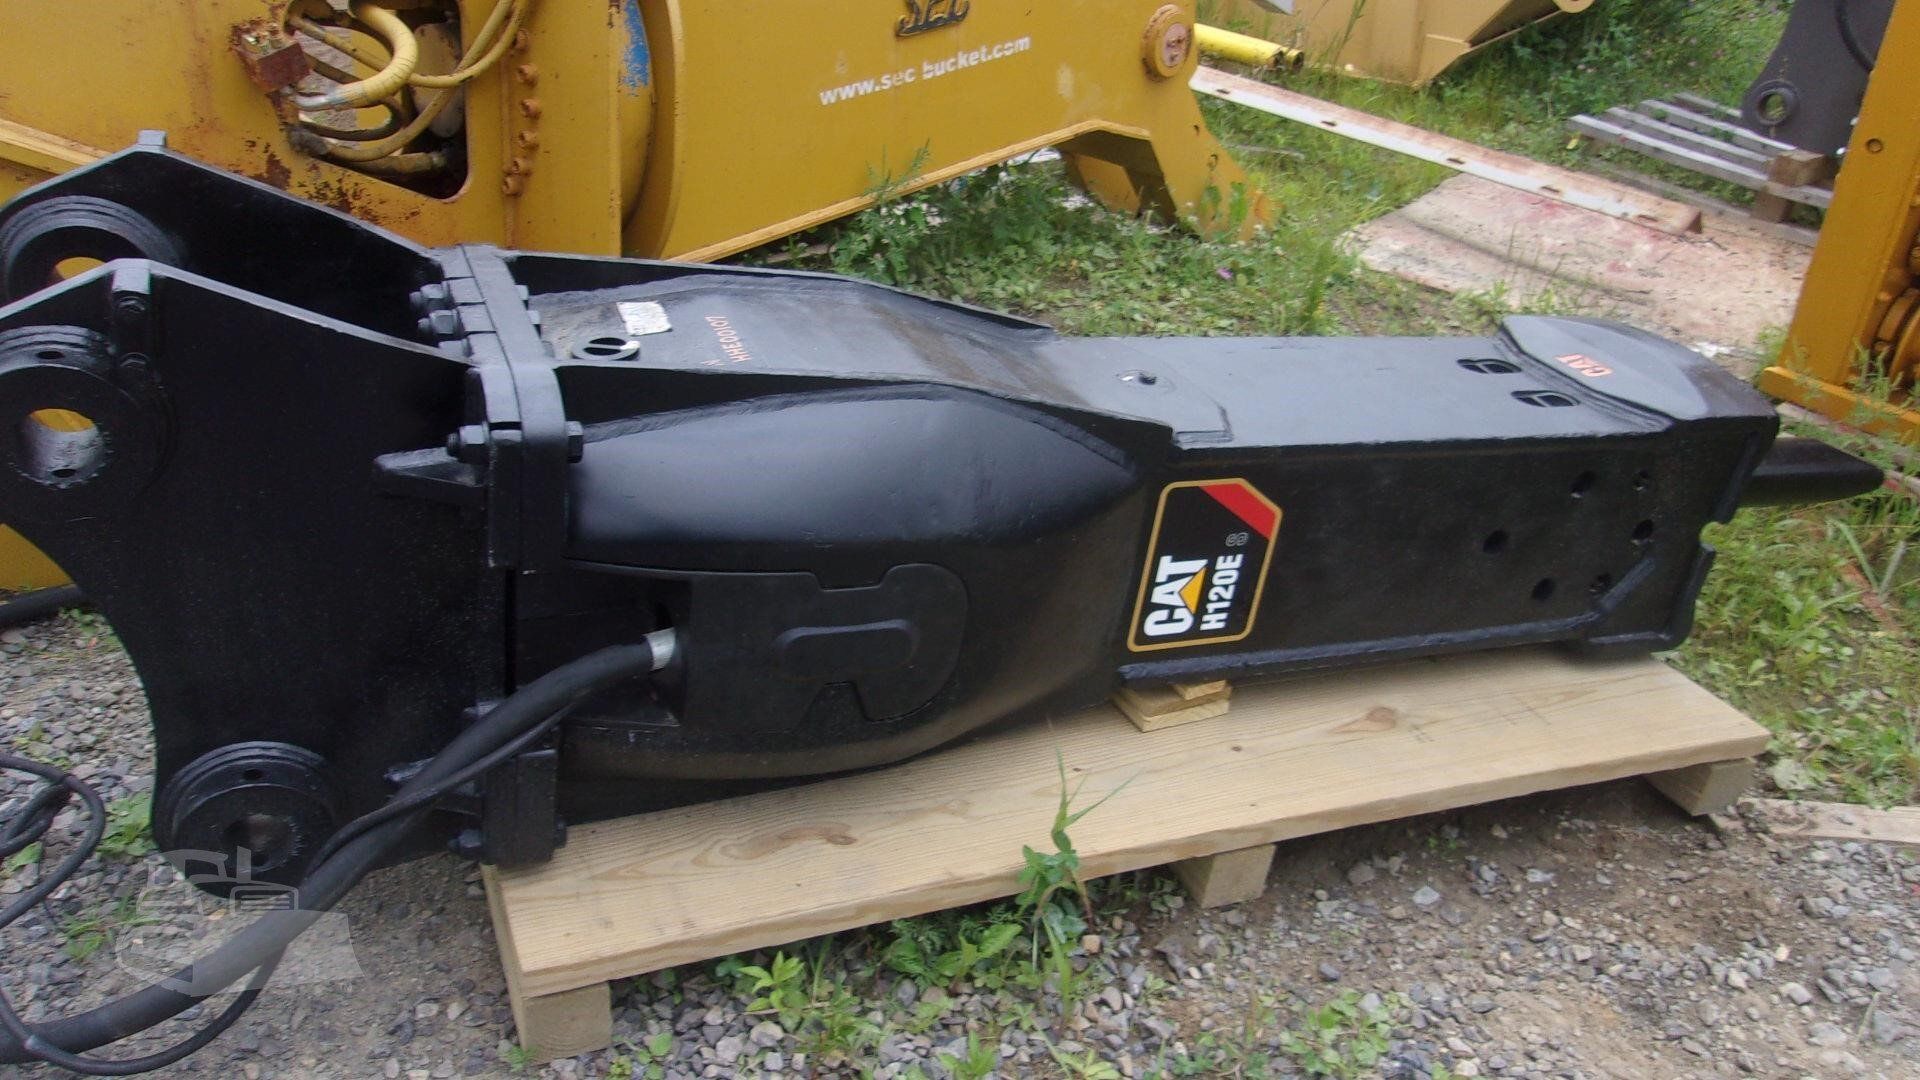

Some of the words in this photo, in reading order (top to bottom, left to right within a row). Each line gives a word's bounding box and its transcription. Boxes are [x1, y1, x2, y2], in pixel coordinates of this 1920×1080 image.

[819, 67, 916, 105] www.sec
[922, 35, 1031, 80] bucket.com
[1553, 353, 1613, 377] CAT
[1143, 555, 1208, 636] CAT
[1200, 554, 1243, 631] H120E
